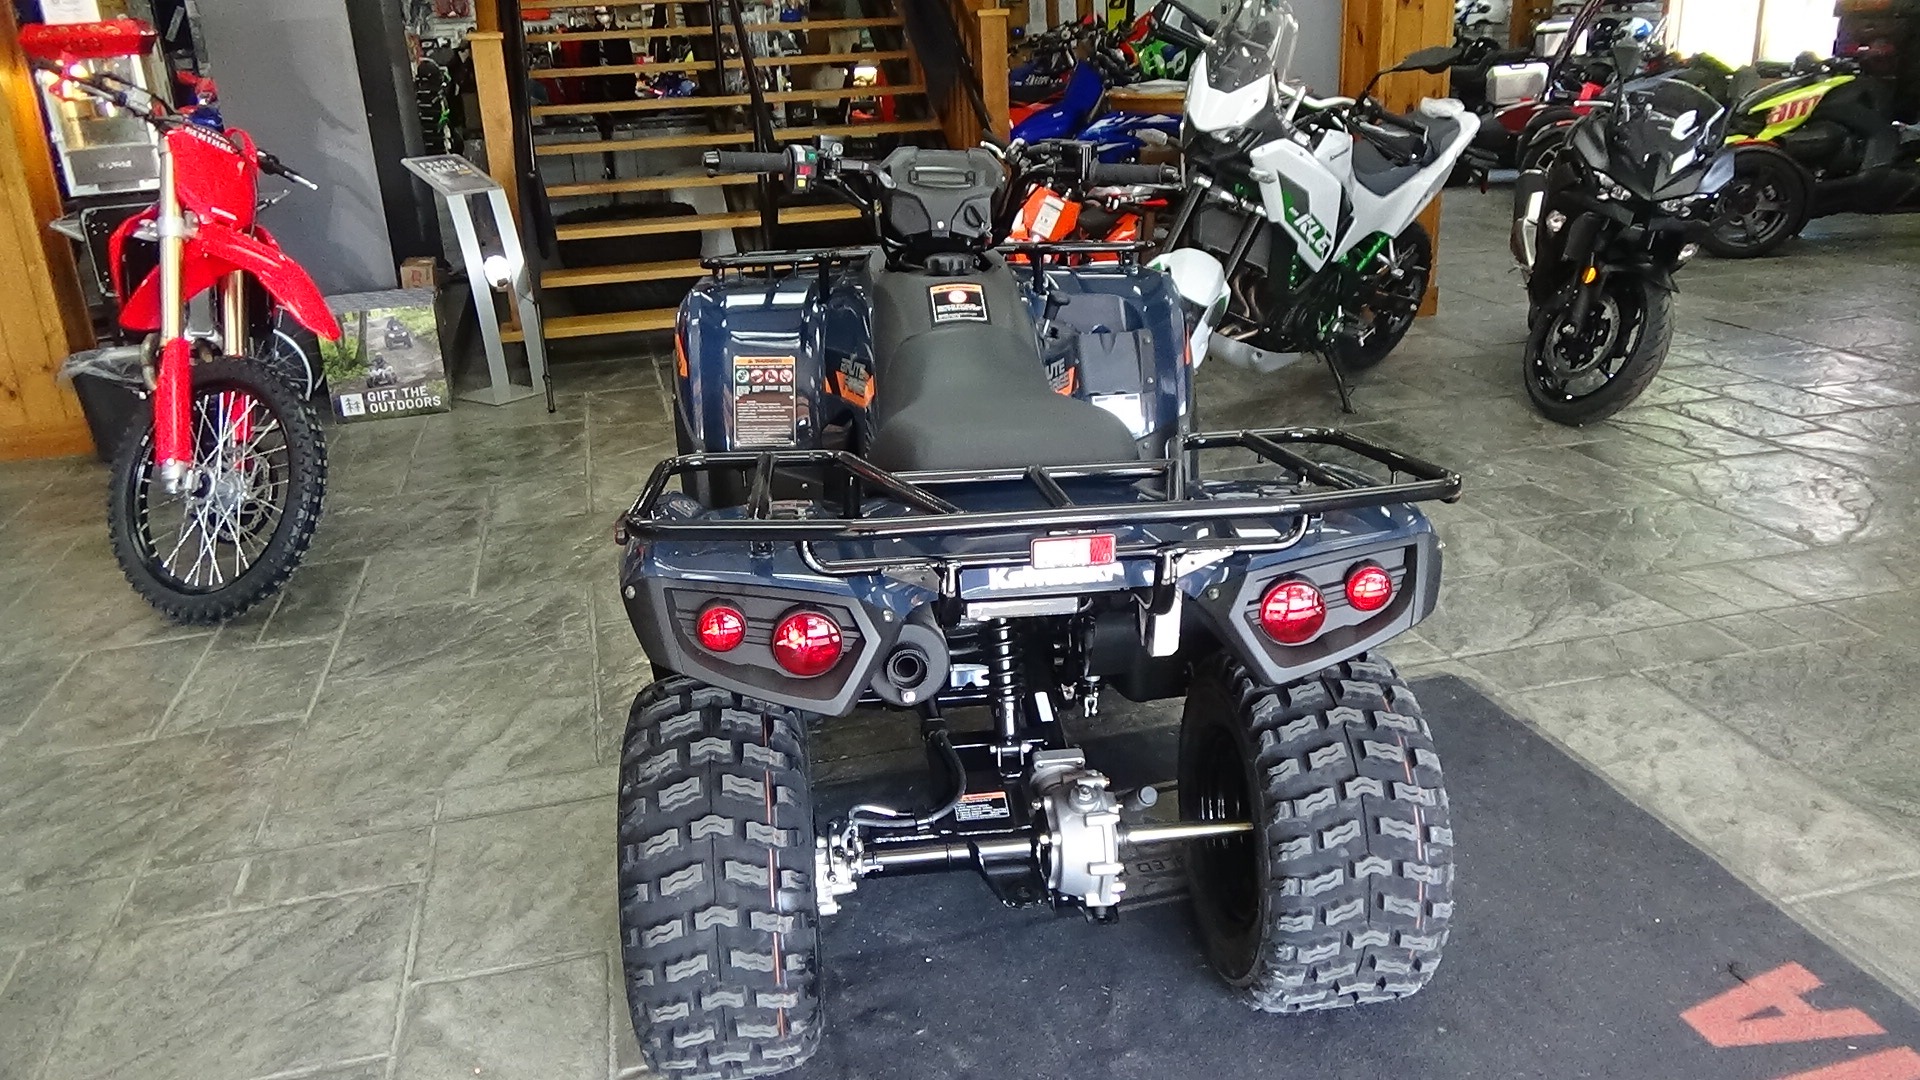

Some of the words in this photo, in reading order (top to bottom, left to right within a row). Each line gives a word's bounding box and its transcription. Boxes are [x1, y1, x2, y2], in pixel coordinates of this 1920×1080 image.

[1045, 358, 1066, 380] UTE
[367, 389, 397, 402] GIFT
[401, 386, 428, 398] THE
[369, 395, 441, 413] OUTDOORS
